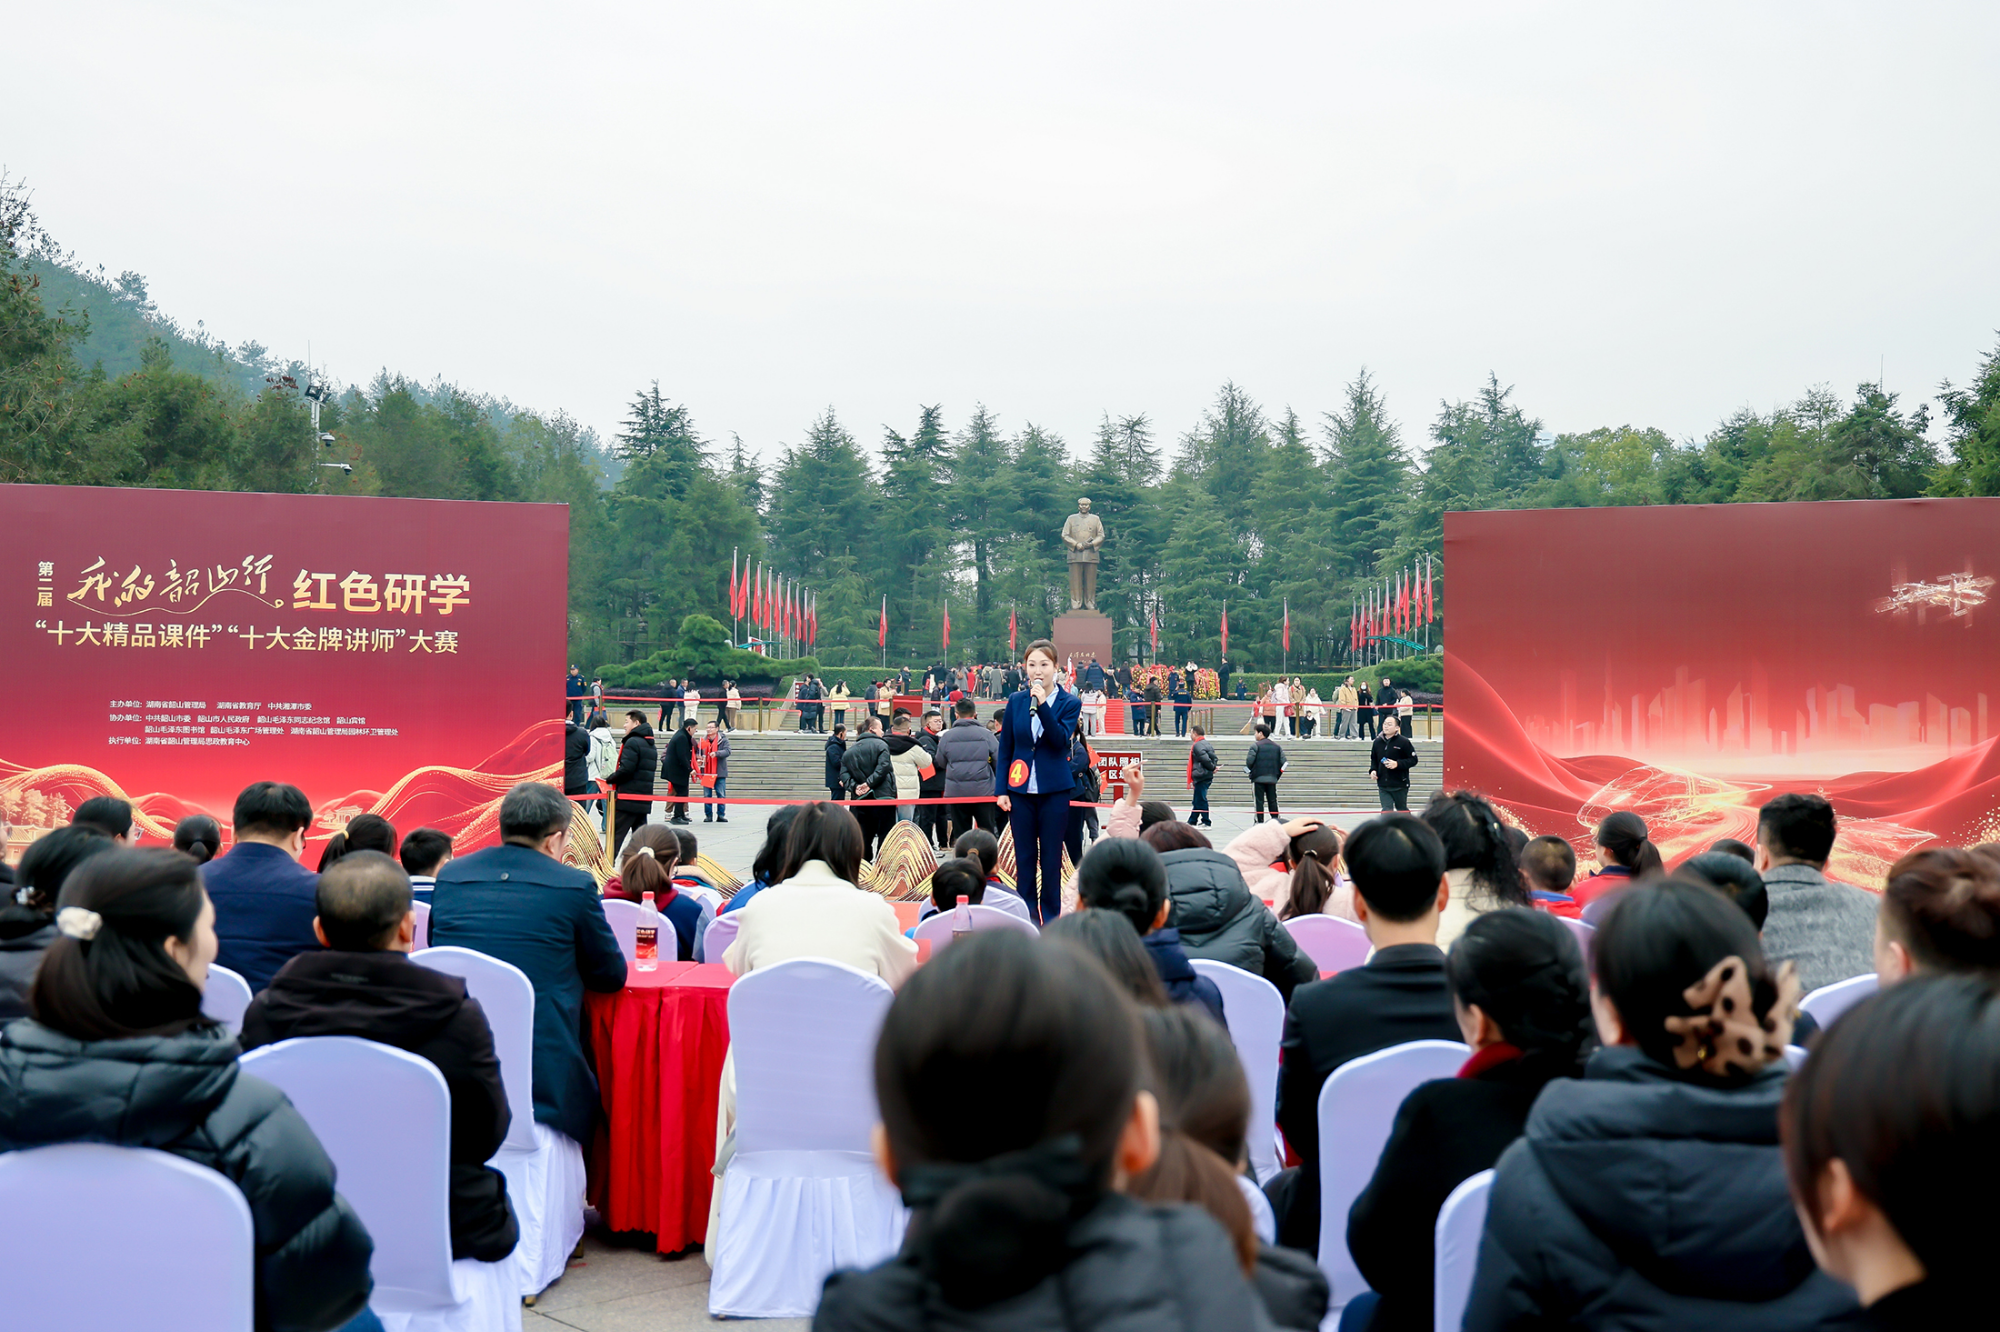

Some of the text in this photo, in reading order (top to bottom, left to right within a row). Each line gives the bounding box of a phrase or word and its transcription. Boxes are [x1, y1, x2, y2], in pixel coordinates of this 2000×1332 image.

[36, 560, 55, 607] 第二届
[67, 554, 471, 615] 我的韶山行 红色研学
[145, 700, 207, 709] 湖南省韶山管理局
[216, 701, 262, 710] 湖南省教育厅
[267, 702, 313, 711] 中共湘潭市委
[145, 714, 192, 723] 中共韶山市委
[197, 715, 250, 724] 韶山市人民政府
[256, 715, 331, 725] 韶山毛泽东同志纪念馆
[336, 716, 366, 725] 韶山宾馆
[144, 725, 399, 737] 韶山毛泽东图书馆 韶山毛泽东广场管理处 湖南省韶山管理局园林环卫管理处
[144, 737, 251, 746] 湖南省韶山管理局思政教育中心
[1097, 756, 1140, 767] 团队照相
[1010, 763, 1023, 783] 4
